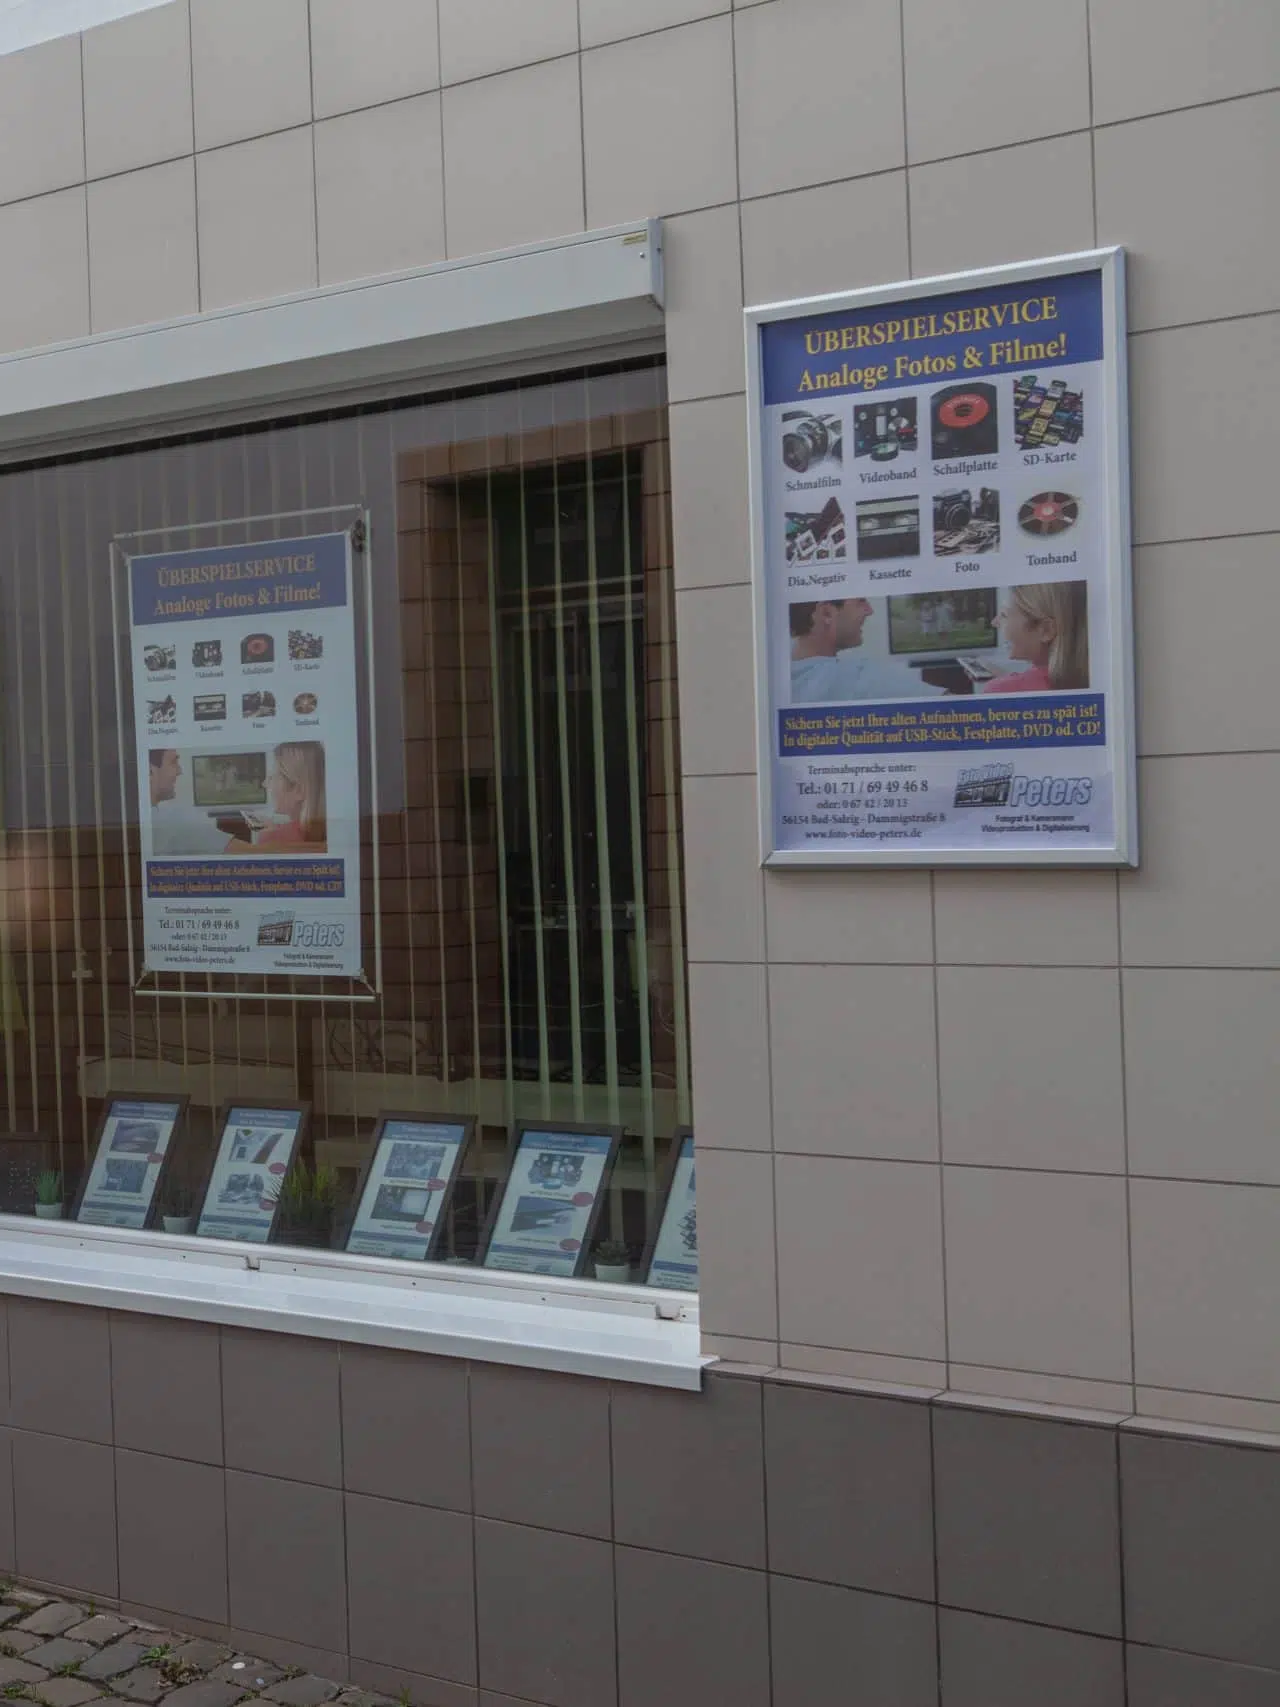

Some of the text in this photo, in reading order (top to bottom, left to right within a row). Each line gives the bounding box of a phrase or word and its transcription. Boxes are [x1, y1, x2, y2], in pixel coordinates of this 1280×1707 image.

[804, 296, 1058, 355] ÜBERSPIELSERVICE
[797, 332, 1067, 392] Analoge Fotos & Filme!
[1023, 452, 1077, 466] SD-Karte
[859, 468, 917, 483] Videoband
[933, 460, 998, 476] Schallplatte
[785, 476, 841, 492] Schmalfilm
[1026, 551, 1077, 566] Tonband
[157, 552, 316, 587] ÜBERSPIELSERVICE
[869, 568, 912, 580] Kassette
[955, 562, 980, 572] Foto
[154, 582, 321, 616] Analoge Fotos & Filme!
[785, 704, 1098, 730] Sichern Sie jetzt Ihre alten Aufnahmen, bevor es zu spät ist!
[783, 734, 794, 747] In
[797, 732, 839, 749] digitaler
[842, 730, 884, 747] Qualität
[886, 729, 903, 743] auf
[1023, 723, 1053, 737] DVD
[1056, 722, 1074, 736] od.
[1077, 721, 1100, 736] CD!
[888, 763, 916, 773] unter:
[824, 782, 838, 795] 01
[841, 782, 855, 794] 71
[867, 781, 882, 793] 69
[885, 781, 899, 793] 49
[902, 780, 918, 792] 46
[920, 780, 929, 792] 8
[1010, 775, 1093, 808] Peters
[292, 920, 345, 947] Peters
